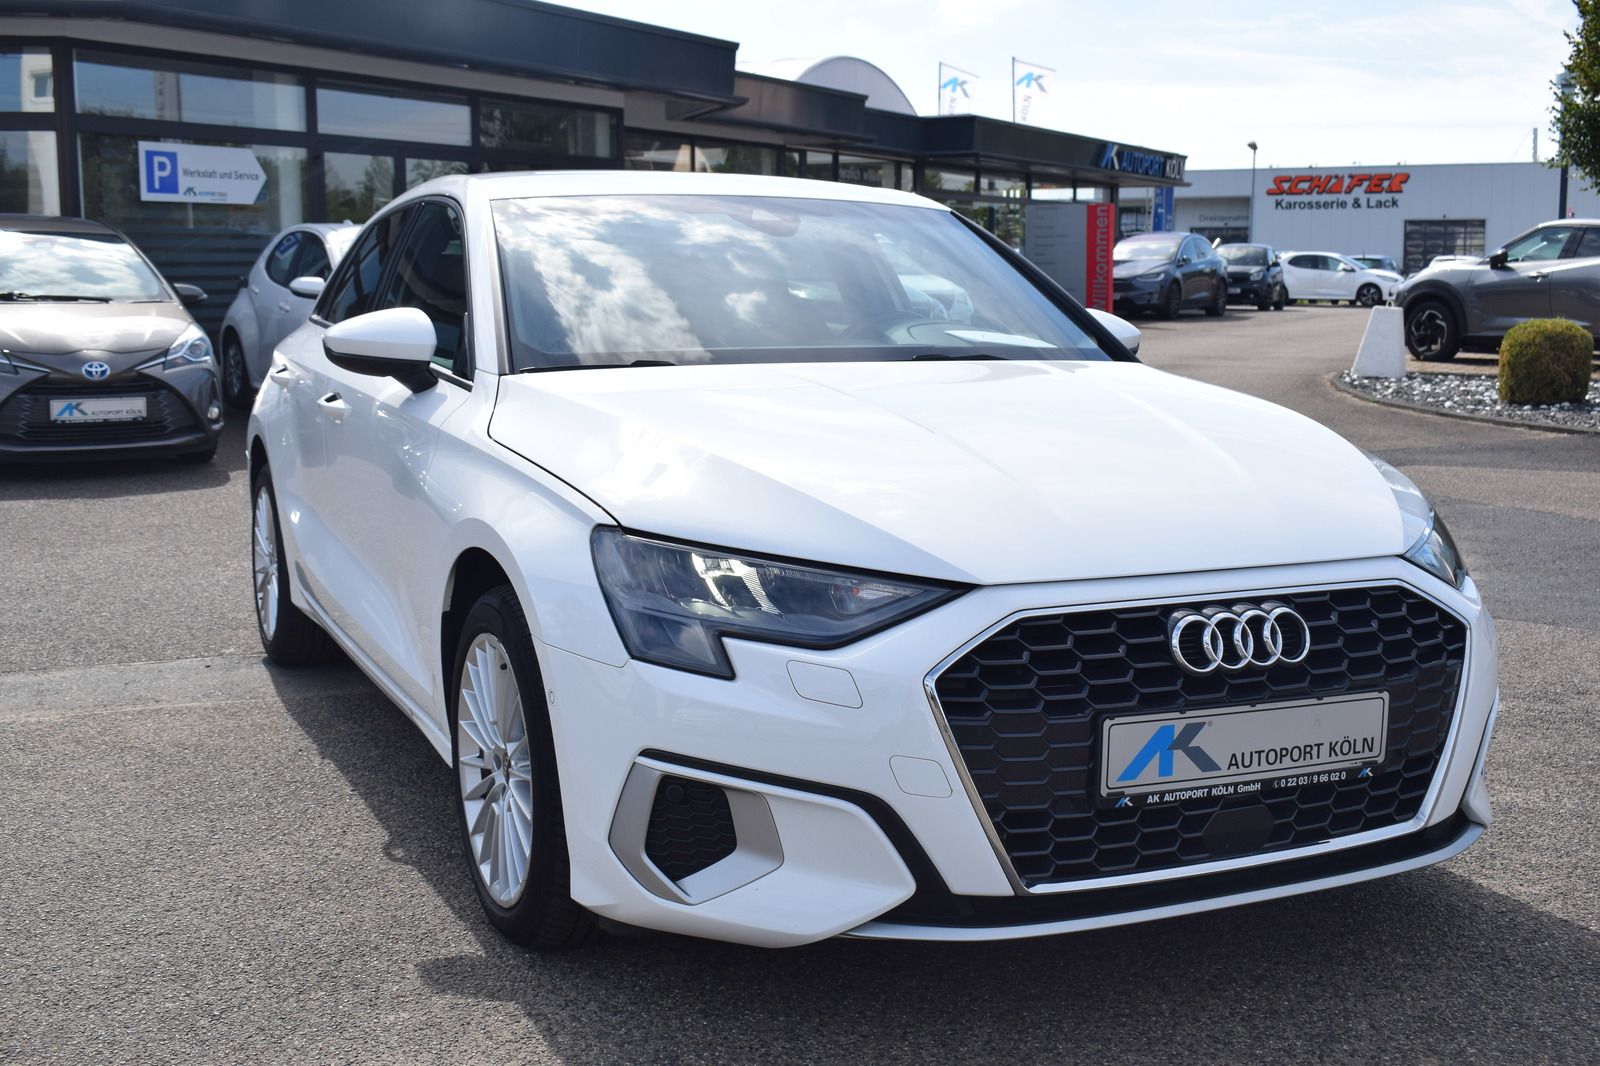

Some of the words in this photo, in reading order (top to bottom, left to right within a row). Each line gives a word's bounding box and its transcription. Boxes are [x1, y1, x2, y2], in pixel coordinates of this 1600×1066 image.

[152, 155, 172, 189] P
[182, 168, 217, 179] Werkstatt
[219, 170, 233, 179] und
[234, 171, 259, 180] Service
[1121, 150, 1164, 176] AUTOPORT
[1266, 173, 1410, 195] SCHÄFER
[1275, 197, 1348, 210] Karosserie
[1352, 198, 1362, 208] &
[1367, 196, 1399, 209] Lack
[125, 408, 142, 416] KÖLN
[1116, 721, 1222, 782] AK
[1227, 743, 1324, 770] AUTOPORT
[1329, 736, 1374, 758] KÖLN
[1330, 772, 1340, 781] 02
[1147, 793, 1160, 804] AK
[1164, 788, 1208, 802] AUTOPORT
[1211, 785, 1234, 796] KÖLN
[1237, 782, 1261, 793] GmbH
